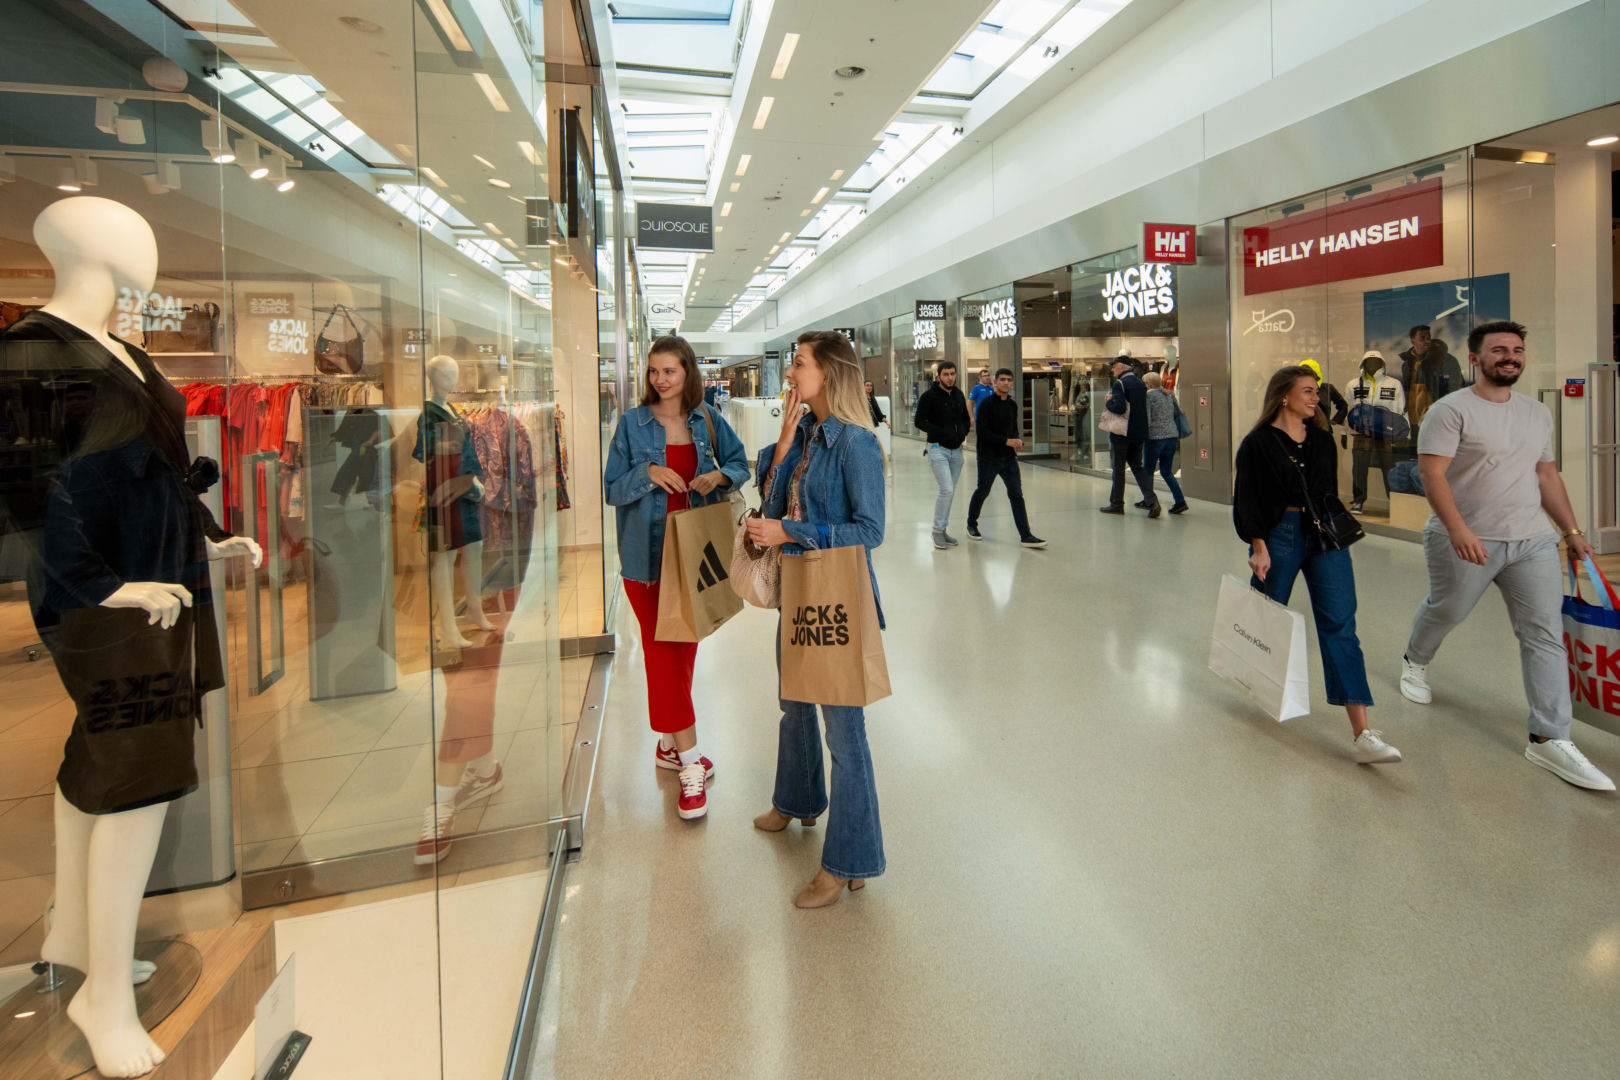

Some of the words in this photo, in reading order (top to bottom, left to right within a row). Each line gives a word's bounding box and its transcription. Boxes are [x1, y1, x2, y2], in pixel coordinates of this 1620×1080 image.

[641, 219, 709, 234] QUIOSQUE
[1255, 239, 1314, 268] HELLY
[1319, 215, 1419, 255] HANSEN
[1101, 263, 1173, 298] JACK&
[918, 304, 944, 312] JACK&
[918, 310, 944, 318] JONES
[980, 298, 1017, 323] JACK&
[1102, 286, 1174, 322] JONES
[912, 320, 936, 337] JACK&
[980, 316, 1019, 341] JONES
[913, 333, 938, 350] JONES
[792, 603, 848, 626] JACK&
[791, 624, 850, 647] JONES
[1233, 623, 1254, 643] Calvin
[1253, 637, 1272, 655] Klein
